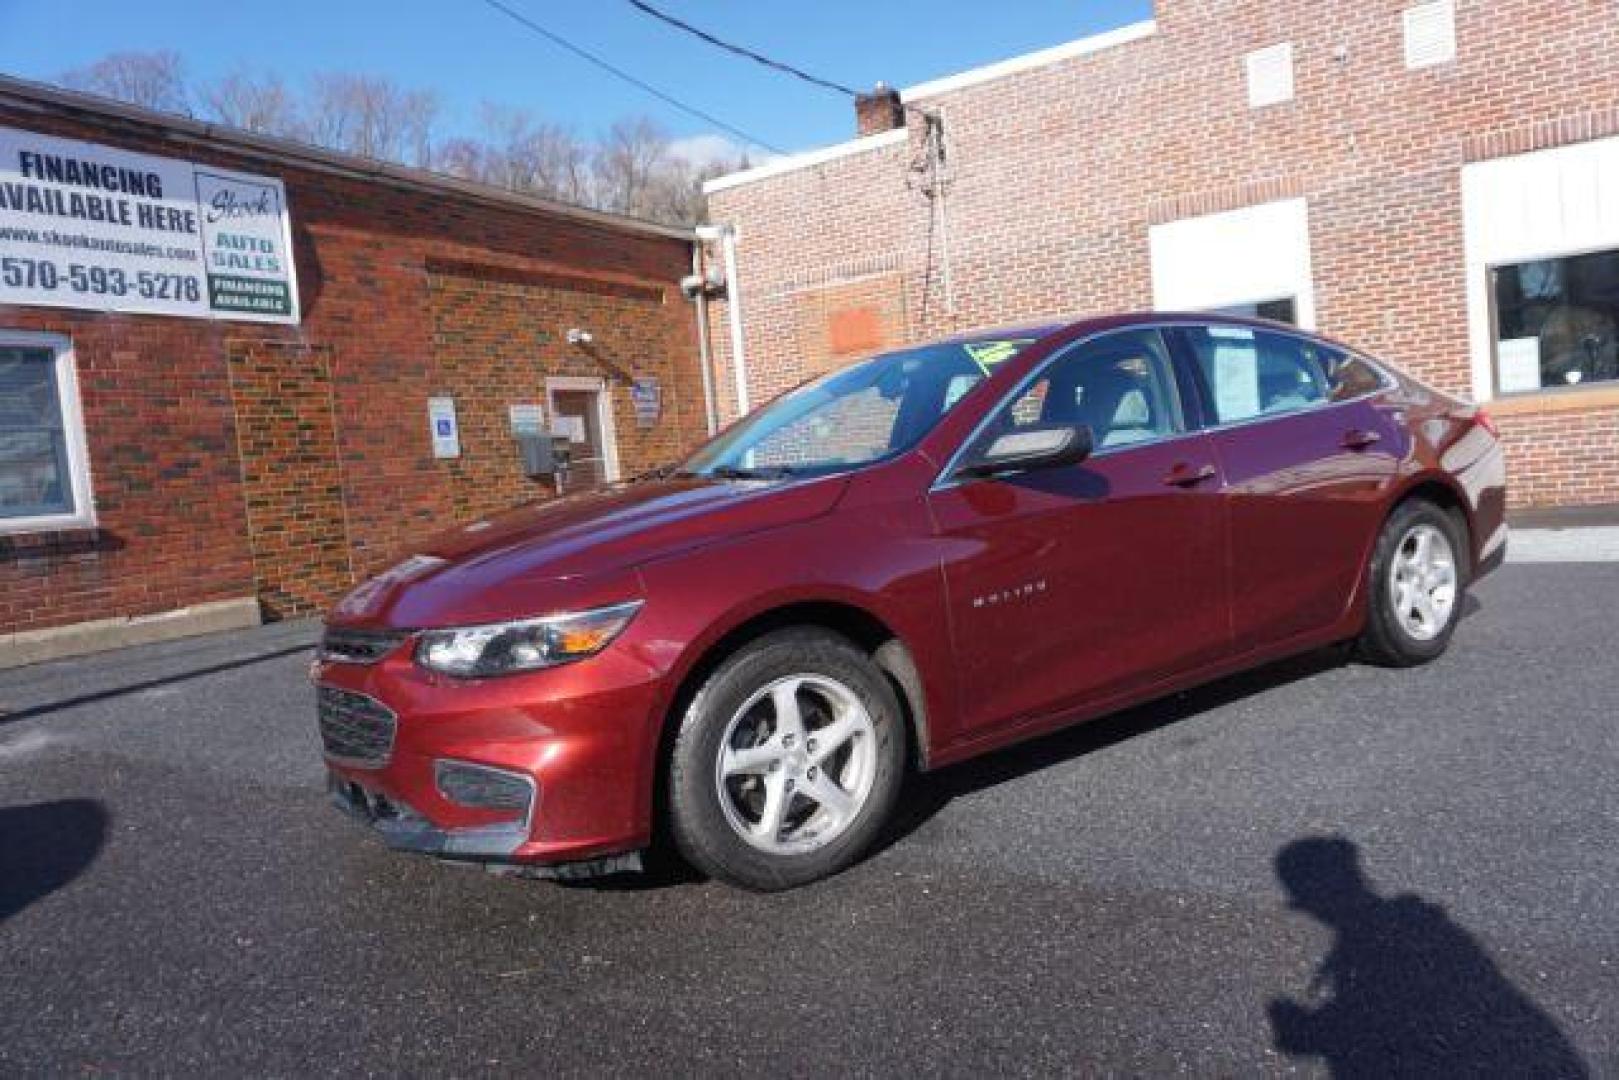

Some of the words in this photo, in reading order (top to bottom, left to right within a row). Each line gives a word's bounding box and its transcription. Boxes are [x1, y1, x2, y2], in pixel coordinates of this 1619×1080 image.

[19, 151, 163, 200] FINANCING
[137, 202, 197, 233] HERE
[217, 232, 274, 254] AUTO
[2, 257, 200, 302] 570-593-5278
